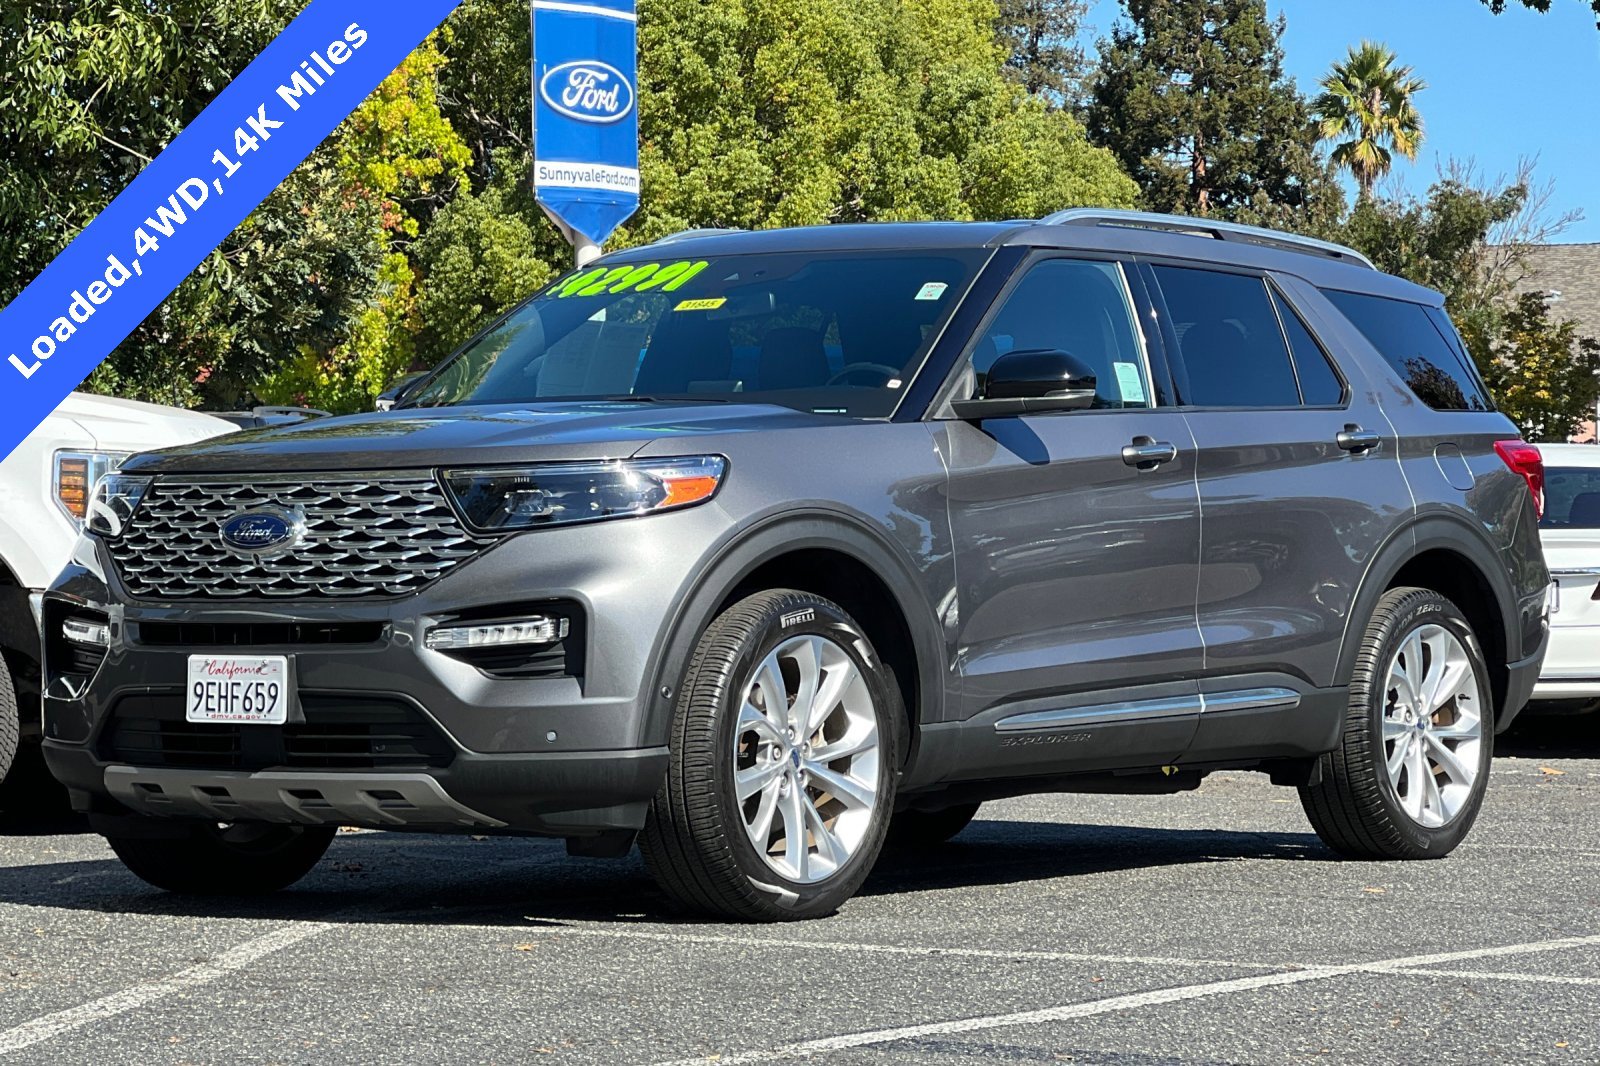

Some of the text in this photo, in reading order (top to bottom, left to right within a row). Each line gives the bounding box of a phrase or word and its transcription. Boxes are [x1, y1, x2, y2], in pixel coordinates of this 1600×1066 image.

[562, 67, 620, 112] Ford
[539, 166, 637, 187] SunnyvaleFord.com
[233, 519, 275, 540] Ford
[780, 607, 815, 629] PIRELLI
[1416, 603, 1442, 616] ZERO
[208, 660, 268, 680] California
[192, 681, 279, 713] 9EHF659
[1000, 733, 1092, 747] EXPLORER
